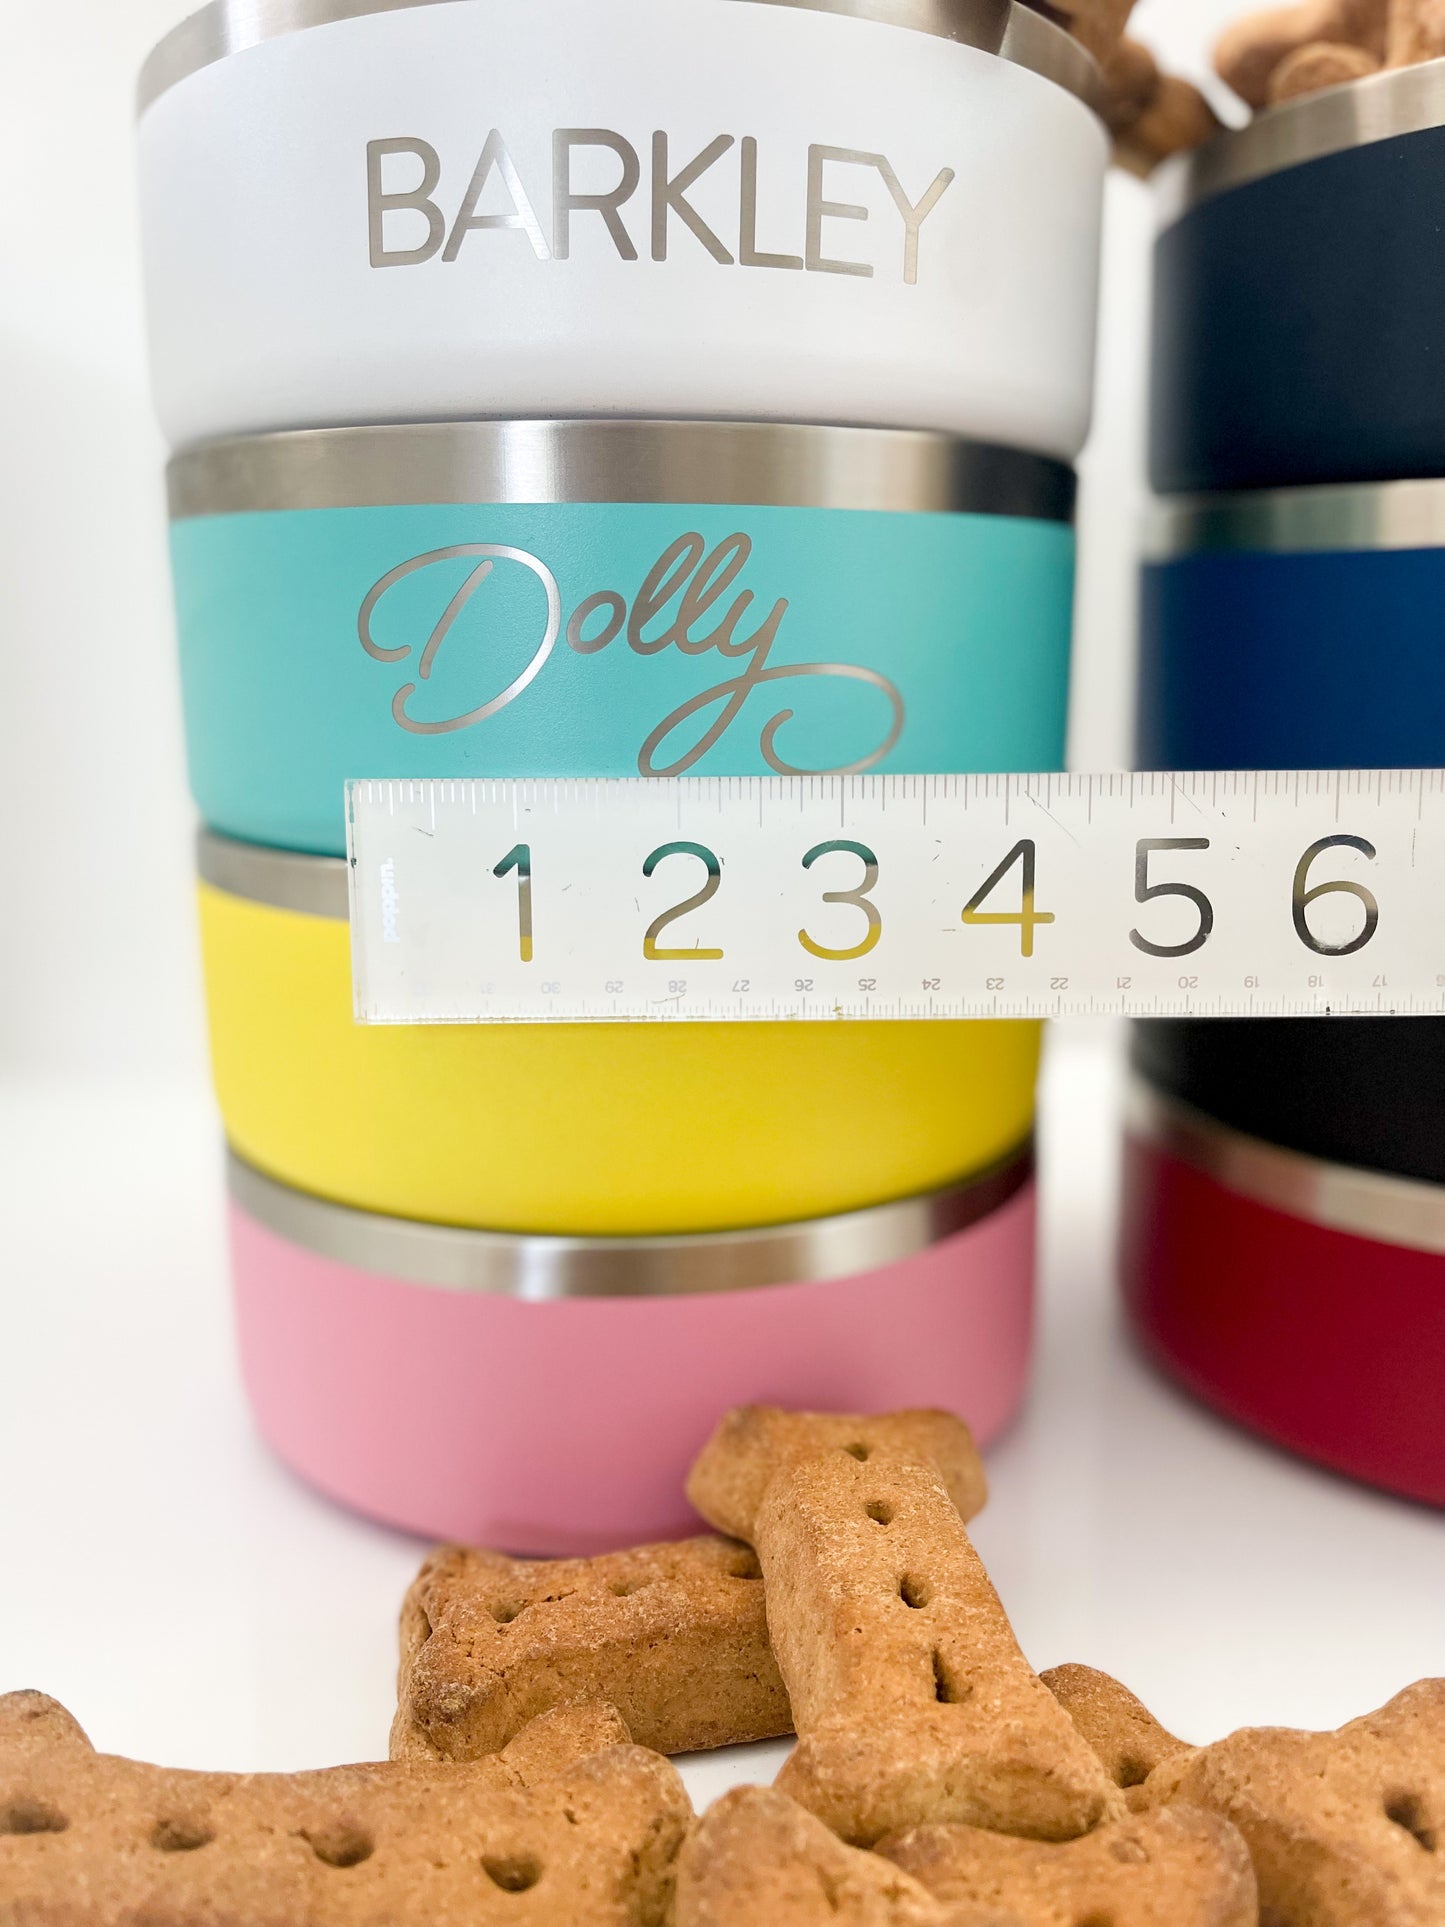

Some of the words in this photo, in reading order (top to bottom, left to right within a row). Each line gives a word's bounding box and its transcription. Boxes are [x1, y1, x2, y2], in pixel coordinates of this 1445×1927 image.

[366, 128, 955, 284] BARKLEY
[357, 532, 903, 778] Dolly
[493, 844, 532, 962] 1
[643, 841, 726, 961] 2
[798, 840, 882, 961] 3
[962, 839, 1055, 957] 4
[1129, 838, 1214, 957] 5
[1292, 834, 1379, 957] 6
[605, 981, 624, 994] 29
[668, 980, 687, 994] 28
[732, 980, 750, 993] 27
[794, 979, 813, 993] 26
[857, 978, 877, 992] 25
[921, 977, 942, 991] 24
[986, 976, 1006, 991] 23
[1050, 976, 1070, 990] 22
[1117, 976, 1132, 990] 21
[1178, 975, 1199, 989] 20
[1243, 975, 1261, 989] 19
[1308, 974, 1325, 988] 18
[1371, 974, 1388, 988] 17
[541, 982, 560, 995] 30
